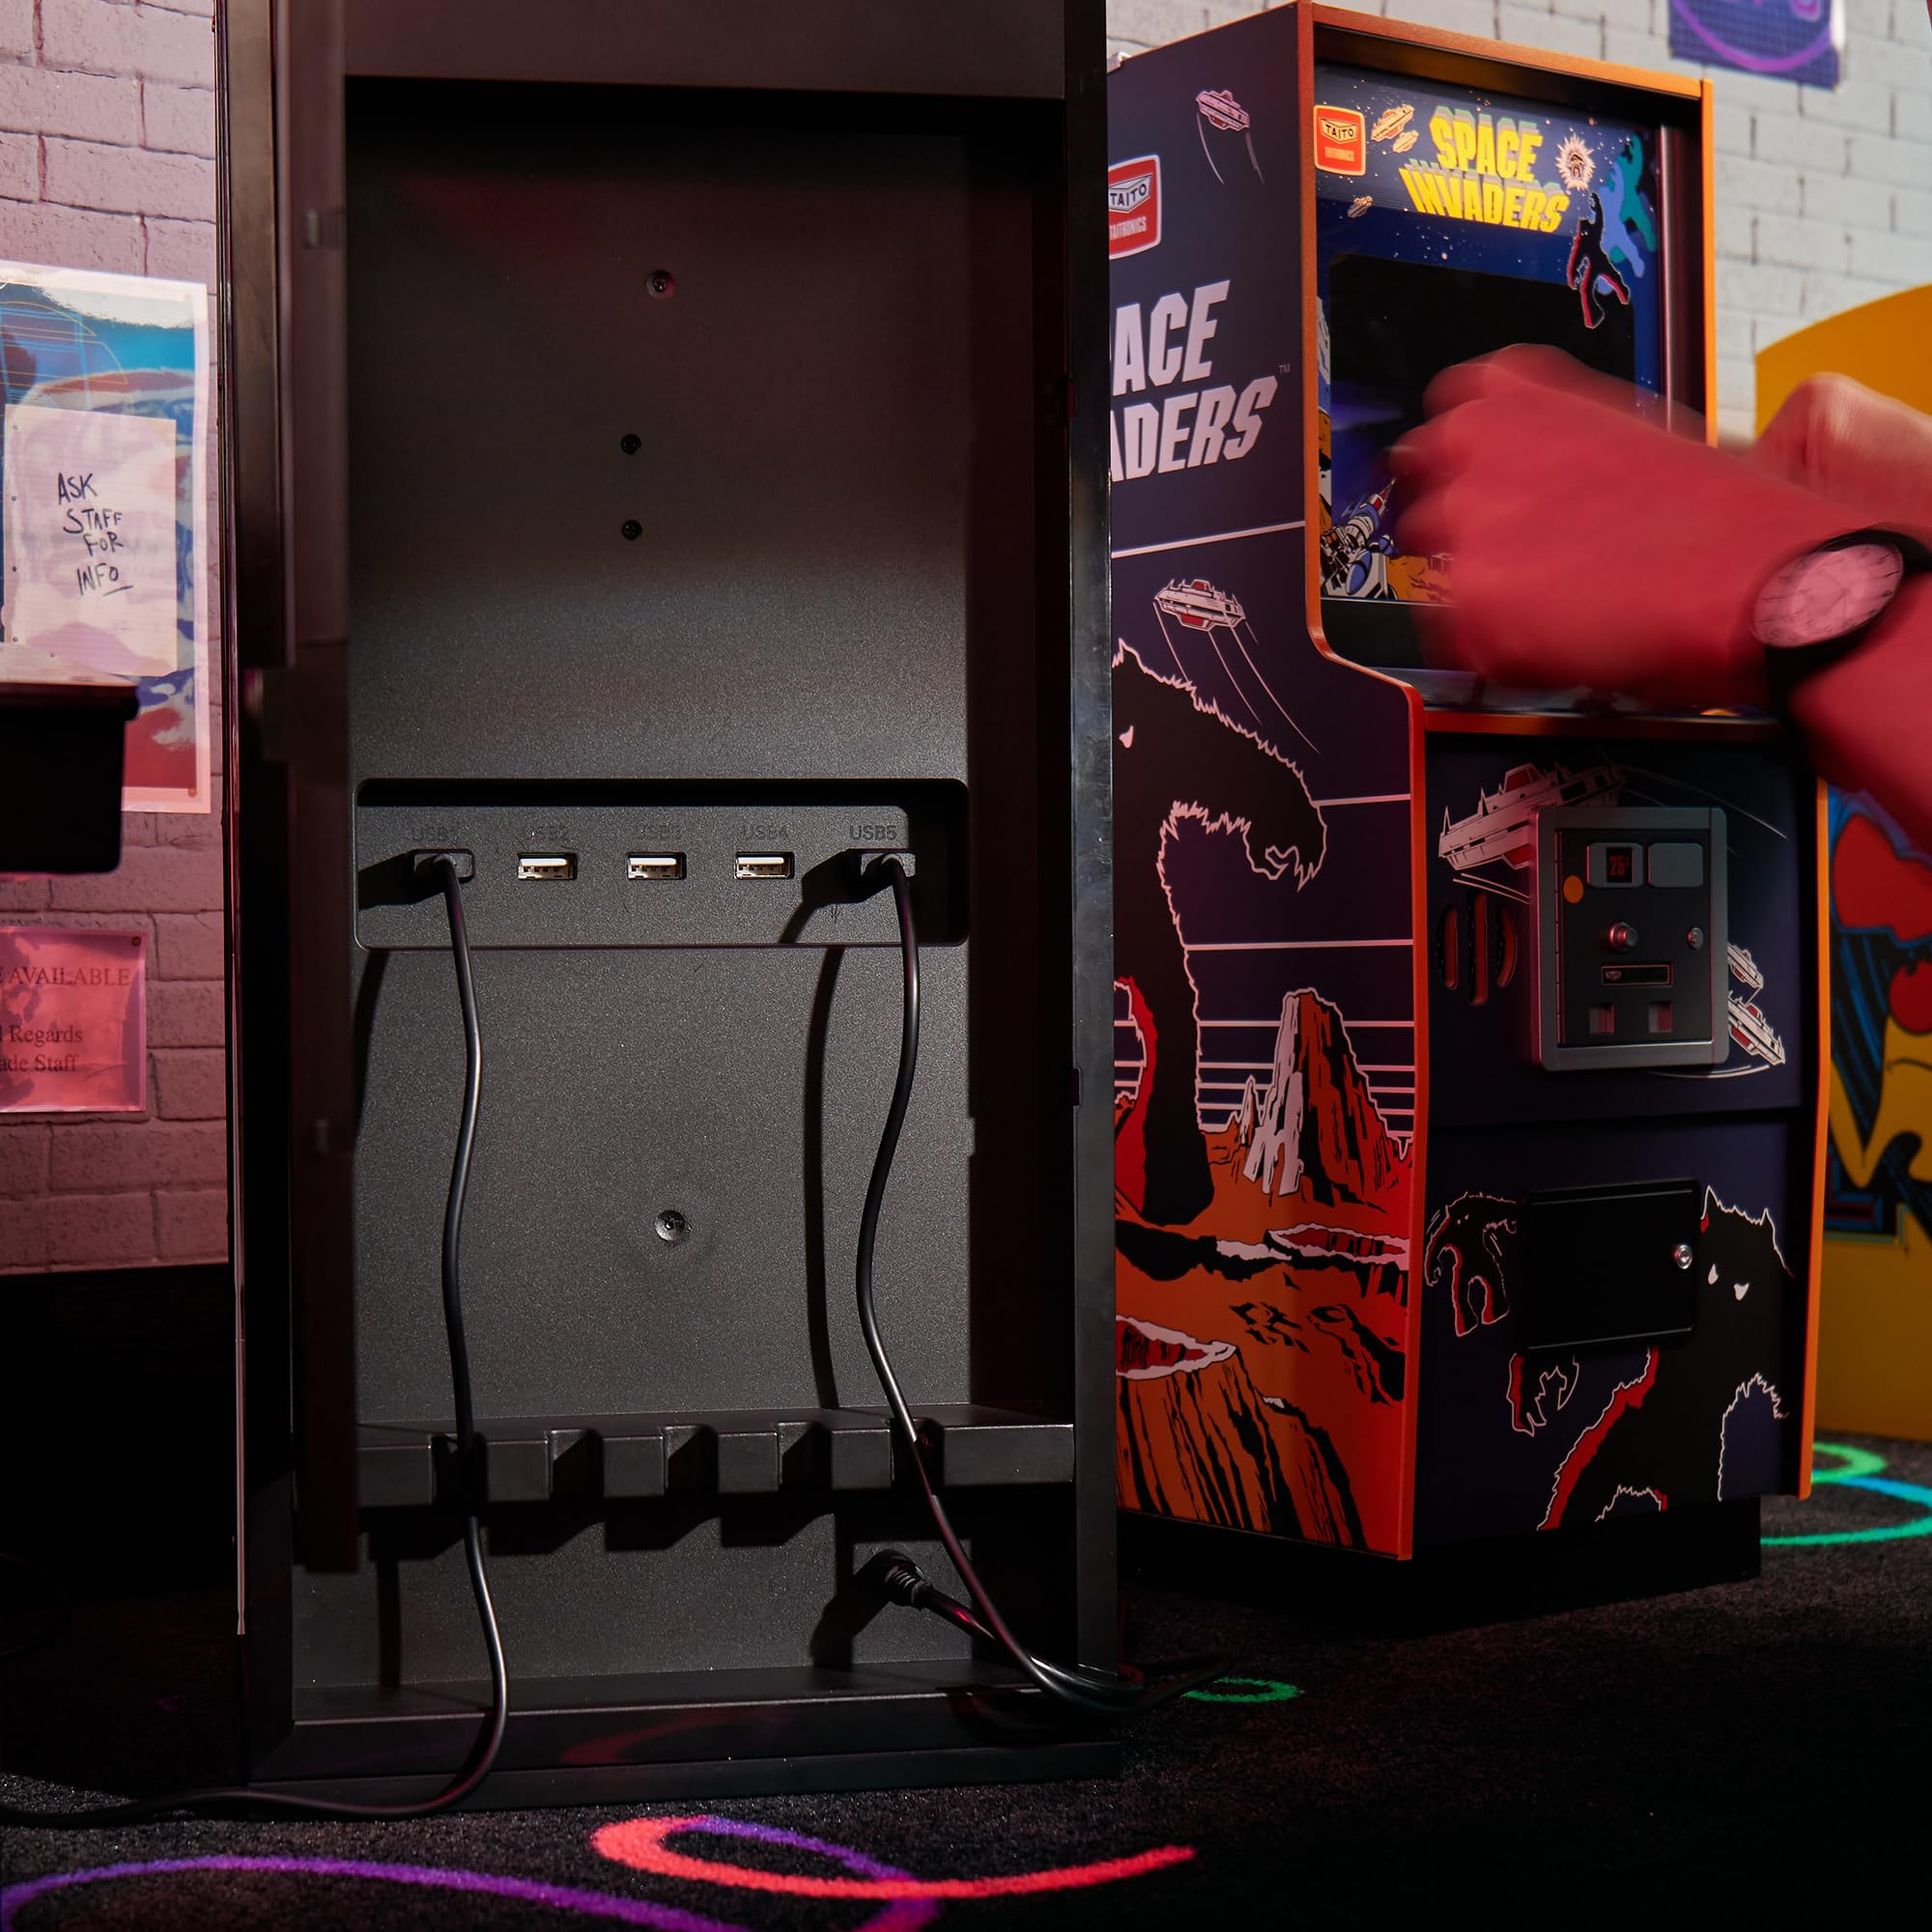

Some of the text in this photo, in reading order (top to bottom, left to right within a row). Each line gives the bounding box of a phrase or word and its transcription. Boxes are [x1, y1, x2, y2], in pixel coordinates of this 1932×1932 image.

[1324, 124, 1354, 140] TAITO
[1429, 106, 1544, 184] SPACE
[1109, 183, 1148, 207] TAITO
[1398, 161, 1571, 234] INVADERS
[1110, 280, 1231, 397] ACE
[58, 471, 98, 505] ASK
[63, 508, 124, 534] STAFF
[83, 531, 124, 557] FOR
[76, 562, 120, 596] INFO
[742, 824, 789, 841] USB4
[849, 825, 897, 841] USB5
[8, 966, 130, 986] AVAILABLE
[10, 1025, 83, 1047] Regards
[0, 1054, 78, 1072] ade Staff
